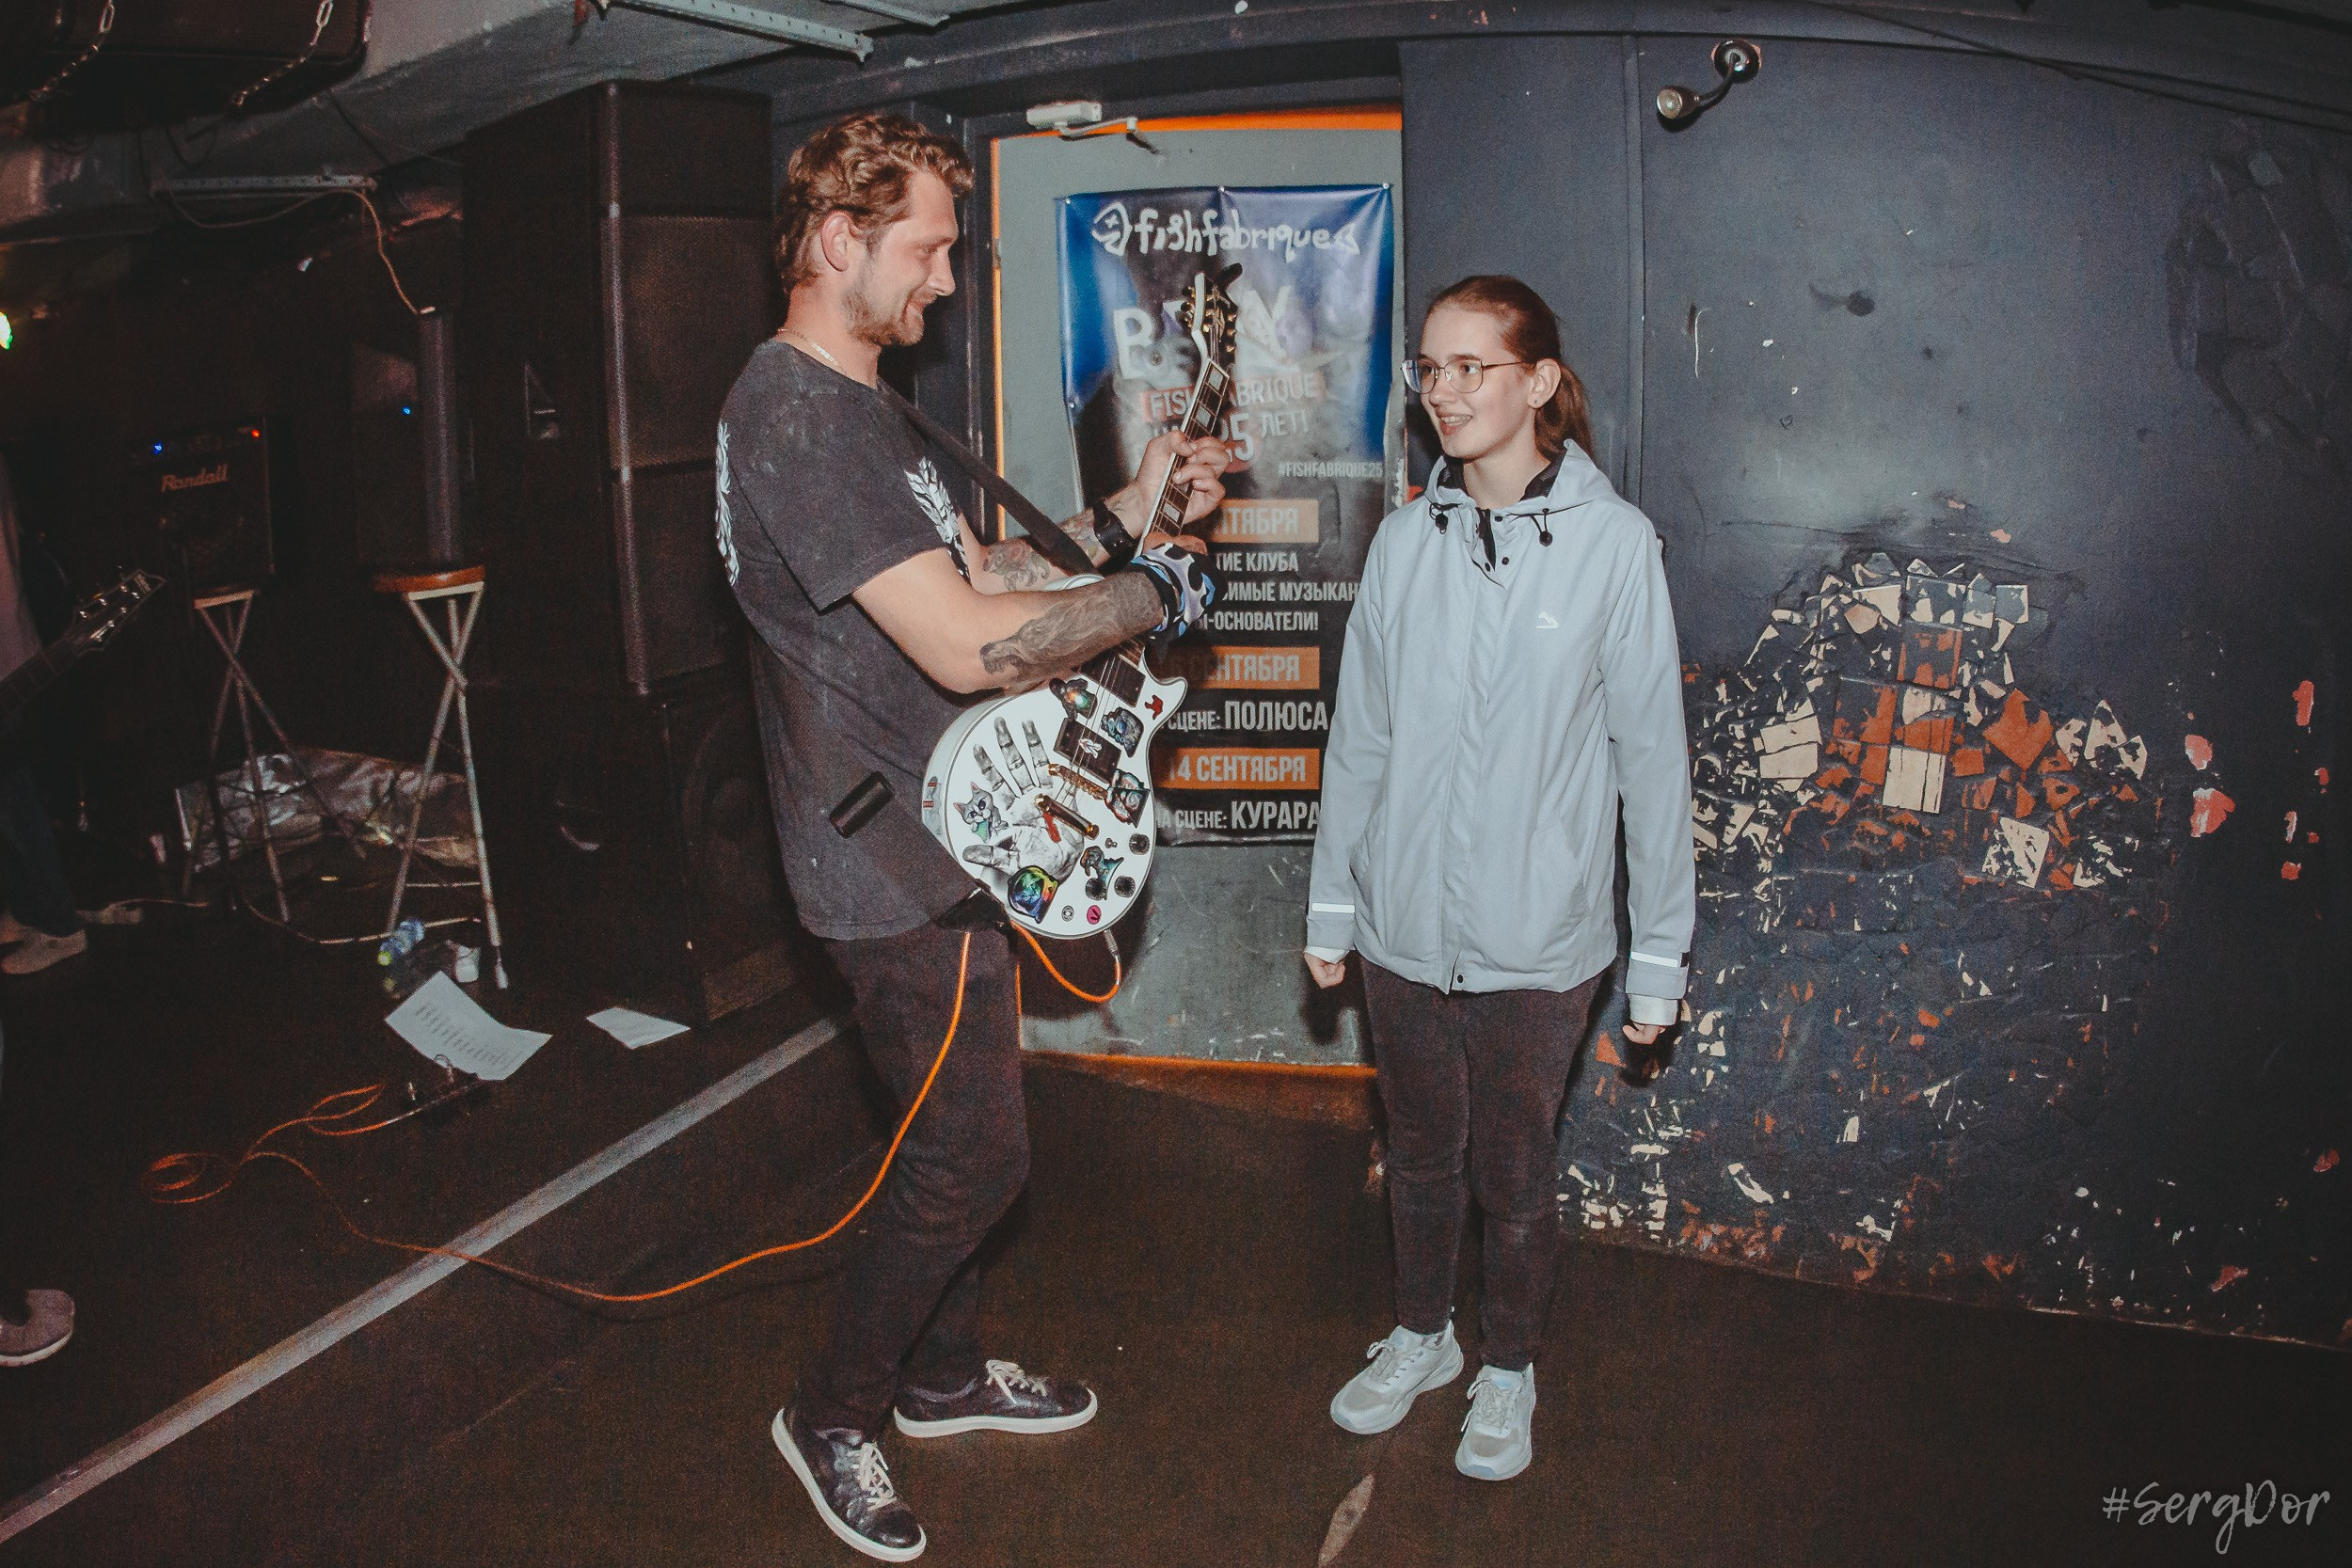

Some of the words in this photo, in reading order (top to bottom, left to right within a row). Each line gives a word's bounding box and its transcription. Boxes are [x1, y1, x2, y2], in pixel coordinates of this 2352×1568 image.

[161, 463, 228, 493] Randall
[1246, 551, 1299, 572] КЛУБА
[1222, 581, 1275, 601] ИМЫЕ
[1279, 580, 1361, 602] МУЗЫКАН
[1168, 710, 1221, 733] СЦЕНЕ:
[1225, 701, 1328, 732] ПОЛЮСА
[1197, 754, 1307, 783] СЕНТЯБРЯ
[1175, 809, 1227, 831] СЦЕНЕ:
